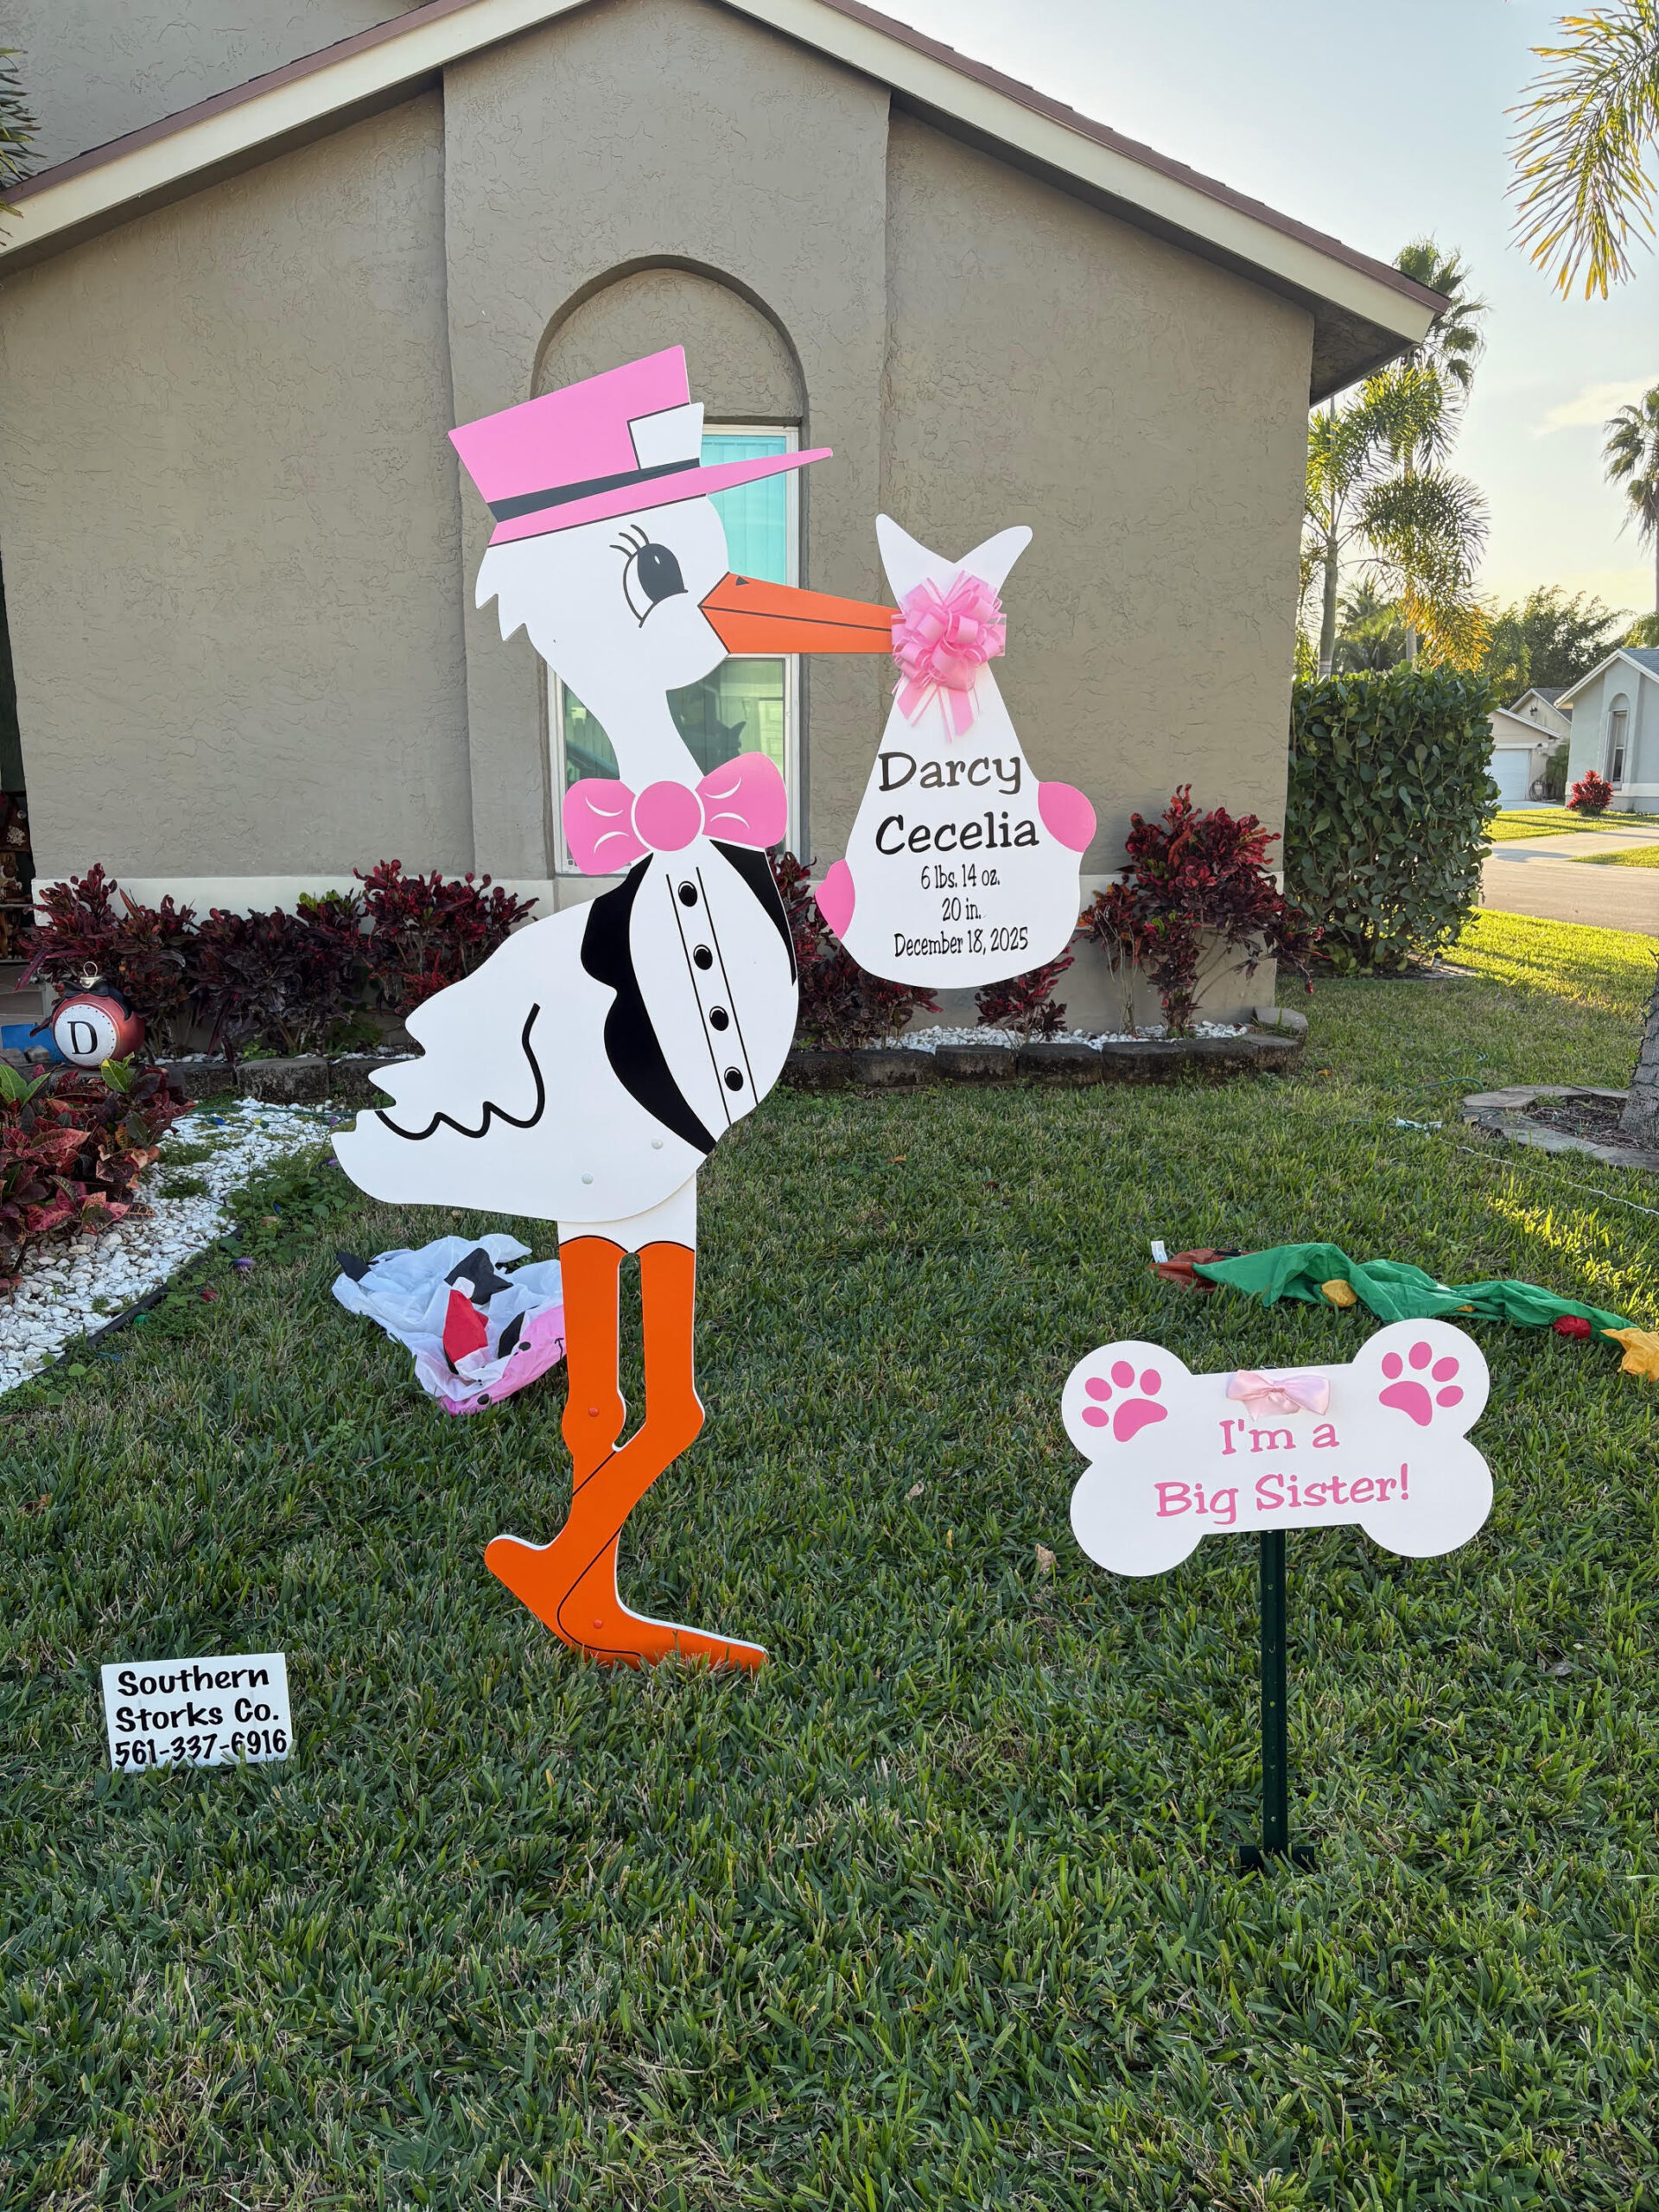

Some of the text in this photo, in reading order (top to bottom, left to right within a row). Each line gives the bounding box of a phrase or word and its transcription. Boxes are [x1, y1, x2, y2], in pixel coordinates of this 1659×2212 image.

[878, 751, 1020, 795] Darcy
[875, 811, 1039, 855] Cecelia
[920, 863, 1000, 889] 6 lbs. 14 oz.
[942, 897, 981, 921] 20 in.
[893, 926, 1028, 957] December 18, 2025
[67, 1020, 98, 1055] D
[1219, 1419, 1339, 1455] I'm a
[1154, 1463, 1409, 1525] Big Sister!
[118, 1665, 270, 1696] Southern
[116, 1698, 279, 1732] Storks Co.
[115, 1729, 287, 1767] 561-337-6916
